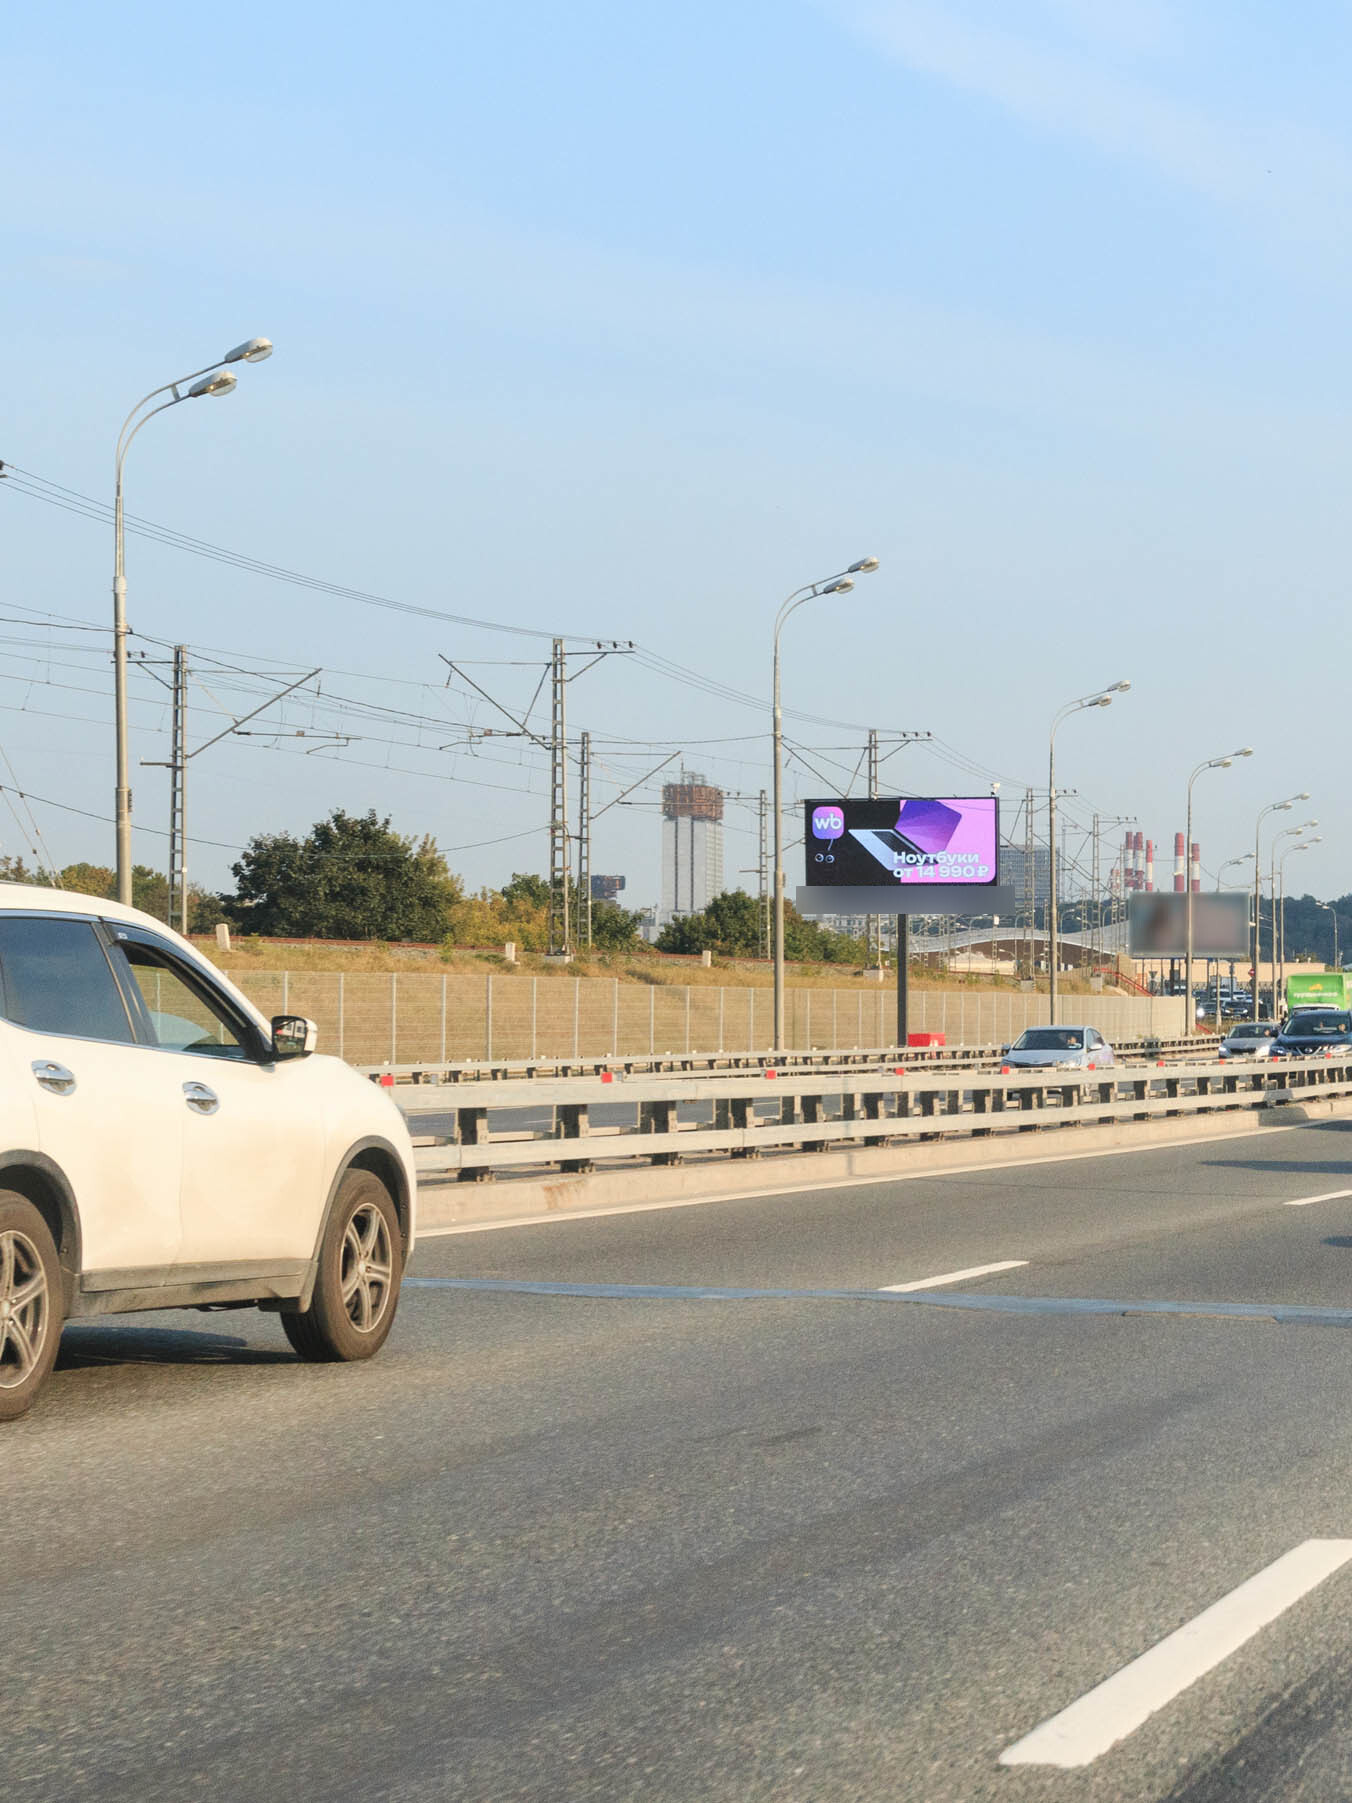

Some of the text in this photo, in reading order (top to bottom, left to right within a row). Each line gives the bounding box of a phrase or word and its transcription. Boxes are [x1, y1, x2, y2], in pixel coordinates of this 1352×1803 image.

[815, 813, 842, 830] wb
[893, 850, 979, 866] Ноутбуки
[893, 867, 913, 878] от
